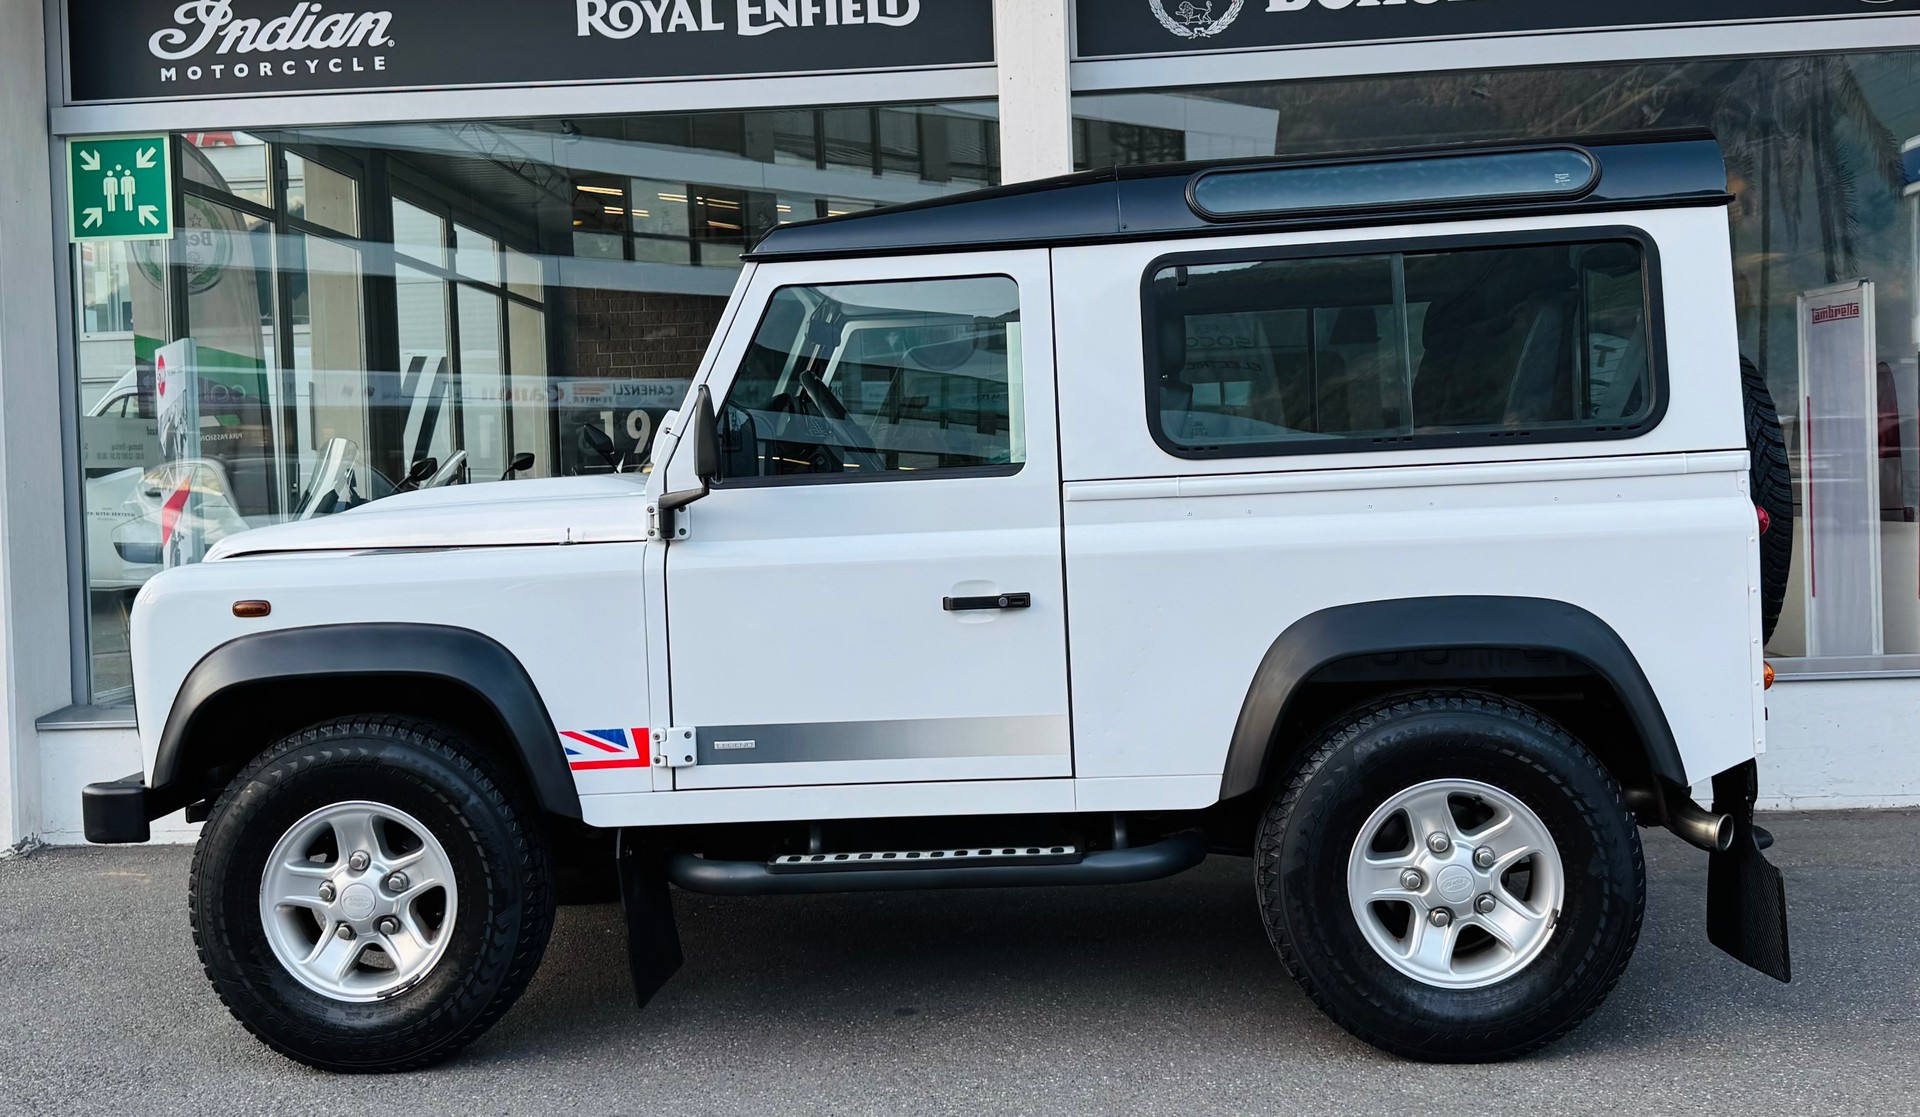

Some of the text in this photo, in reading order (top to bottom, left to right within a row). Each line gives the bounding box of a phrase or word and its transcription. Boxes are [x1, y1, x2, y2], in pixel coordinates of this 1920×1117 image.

[148, 0, 391, 60] Indian
[577, 0, 725, 39] ROYAL
[160, 56, 386, 82] MOTORCYCLE
